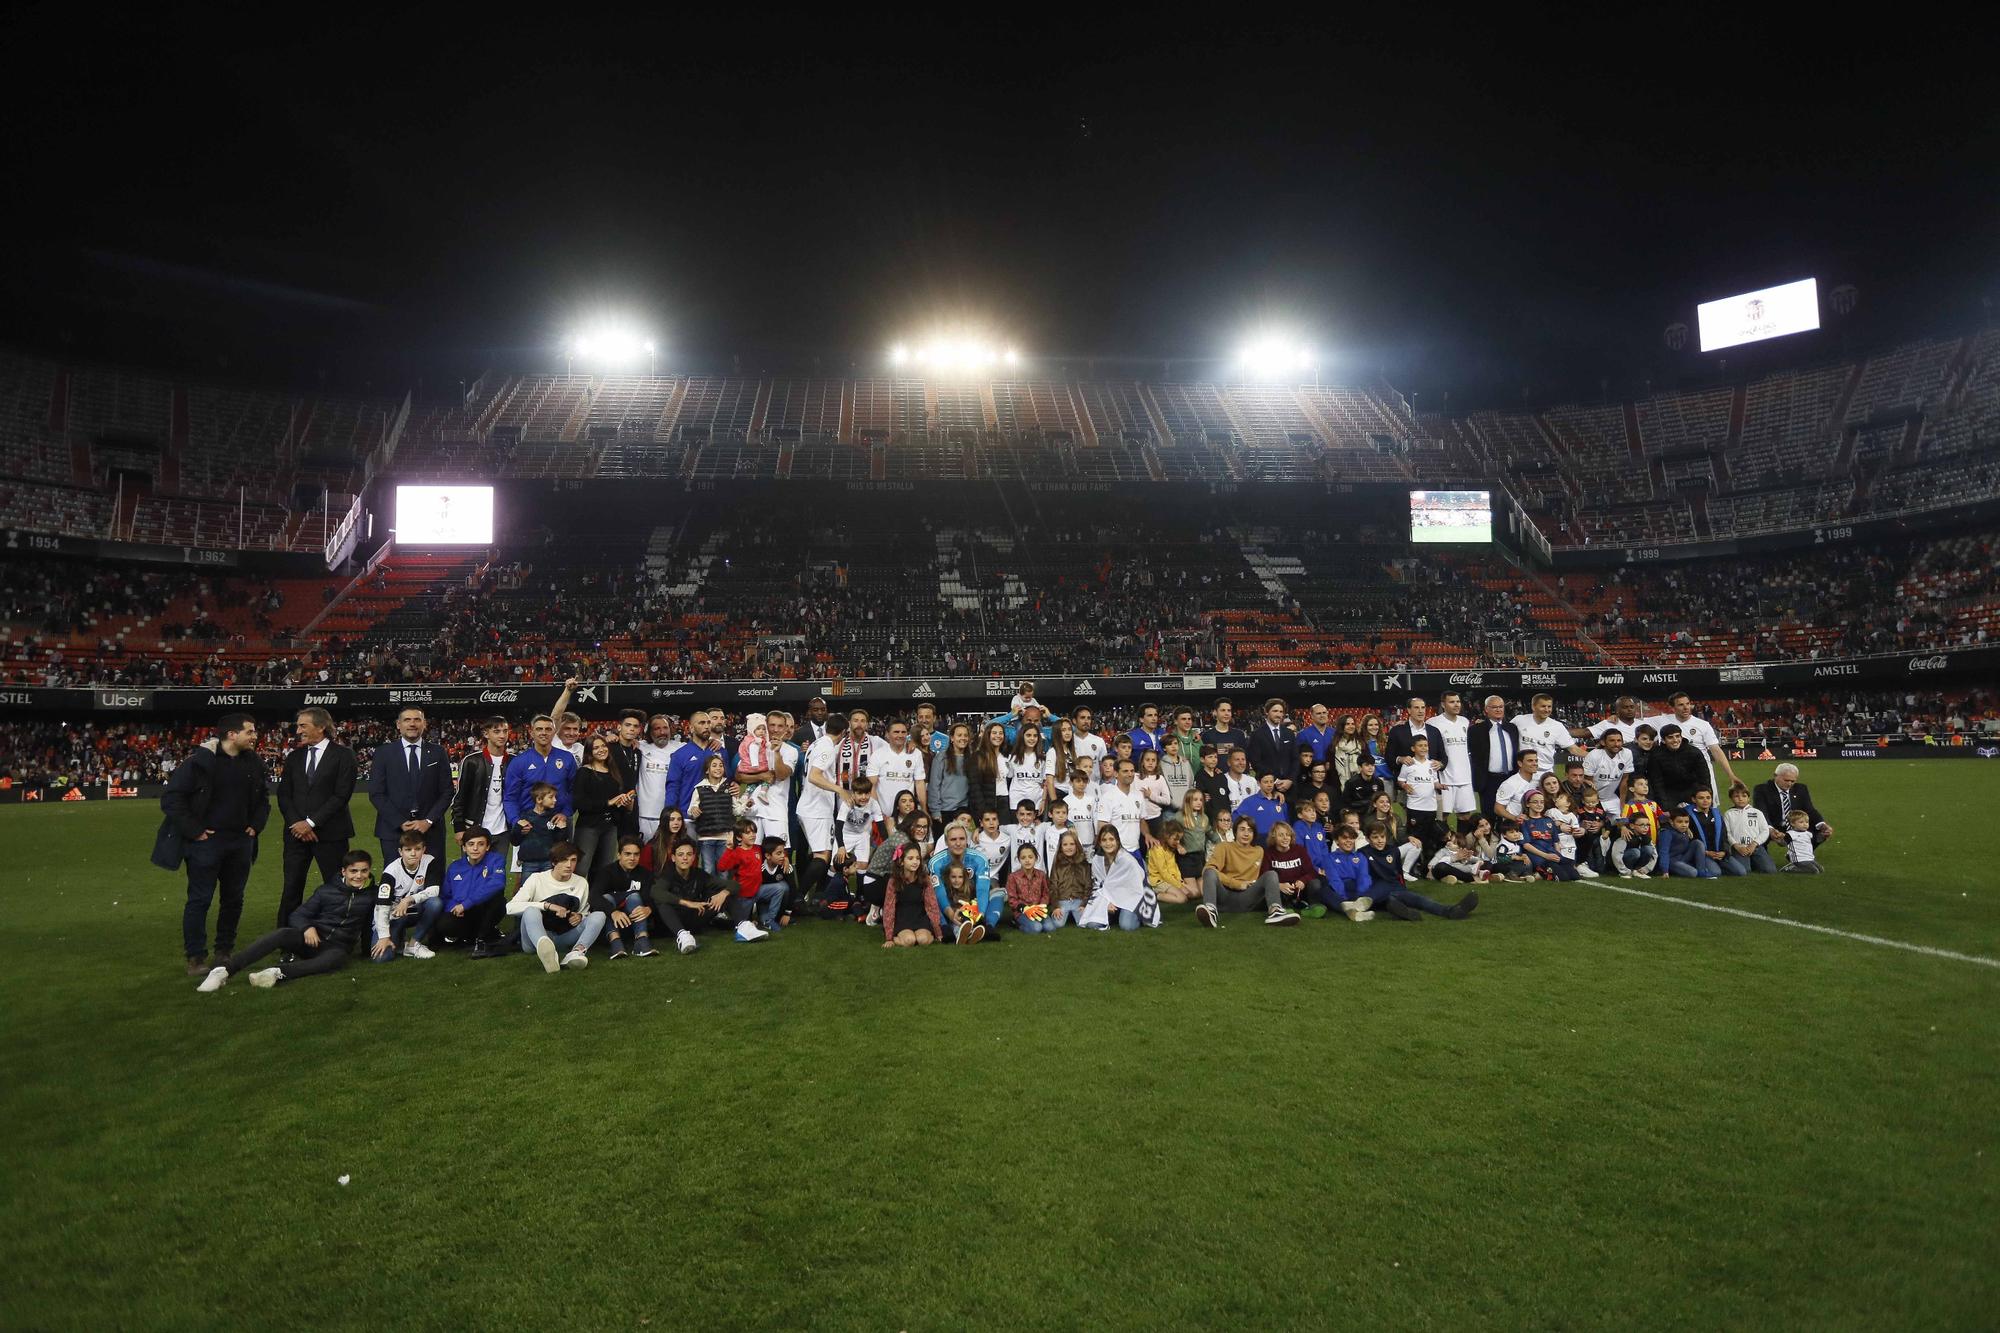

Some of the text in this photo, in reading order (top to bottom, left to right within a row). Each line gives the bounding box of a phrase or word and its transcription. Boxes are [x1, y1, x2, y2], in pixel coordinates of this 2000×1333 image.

[1827, 527, 1852, 540] 1999
[29, 535, 60, 550] 1954
[199, 550, 226, 563] 1962
[1638, 548, 1660, 560] 1999
[1732, 669, 1763, 677] REALE
[1814, 664, 1859, 677] AMSTEL
[1597, 673, 1625, 685] bwin
[1642, 673, 1678, 683] AMSTEL
[738, 686, 774, 697] sesderma
[986, 681, 1024, 690] BLU
[1222, 681, 1256, 690] sesderma
[102, 693, 145, 706] Uber
[207, 694, 254, 706] AMSTEL
[303, 691, 338, 705] bwin
[1791, 748, 1817, 756] BLU
[886, 771, 911, 779] BLU
[1748, 819, 1757, 827] 01
